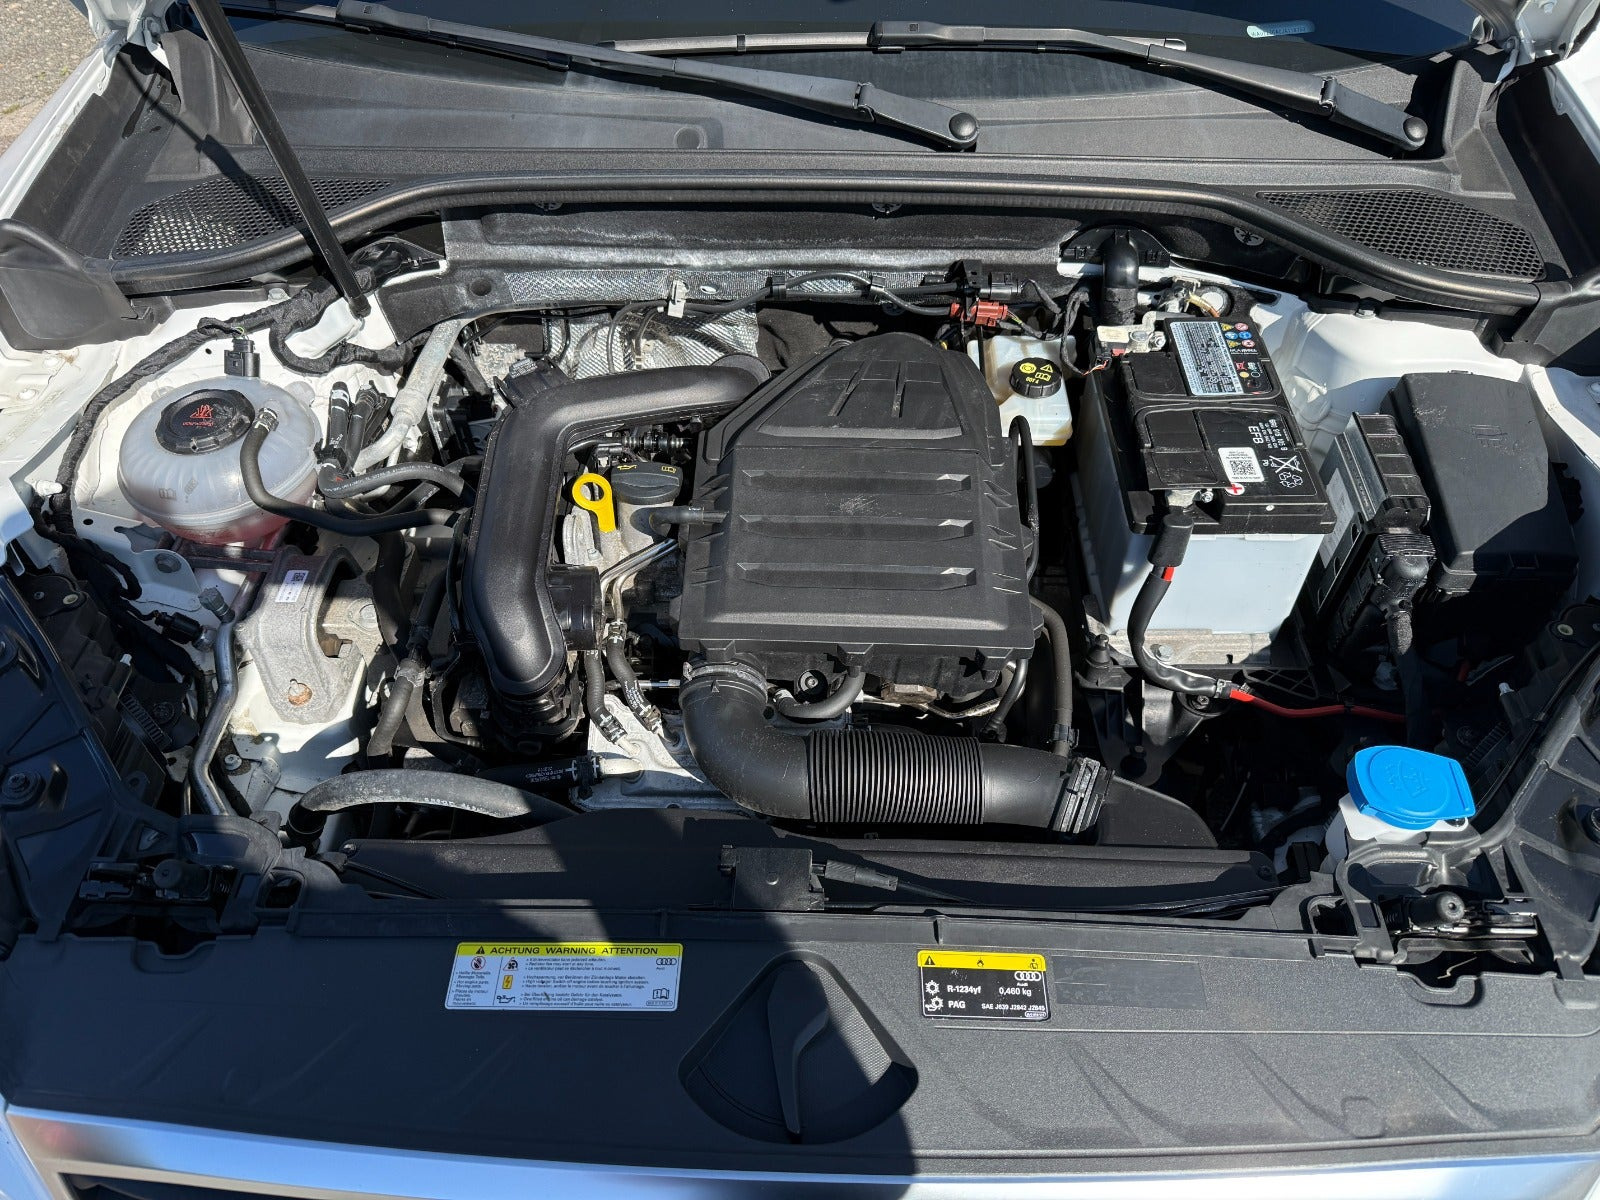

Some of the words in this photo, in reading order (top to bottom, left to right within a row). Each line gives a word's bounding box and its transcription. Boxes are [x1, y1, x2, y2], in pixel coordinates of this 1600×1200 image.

[1248, 426, 1264, 444] EFB
[947, 985, 981, 995] R-1234yf
[1022, 988, 1032, 996] kg
